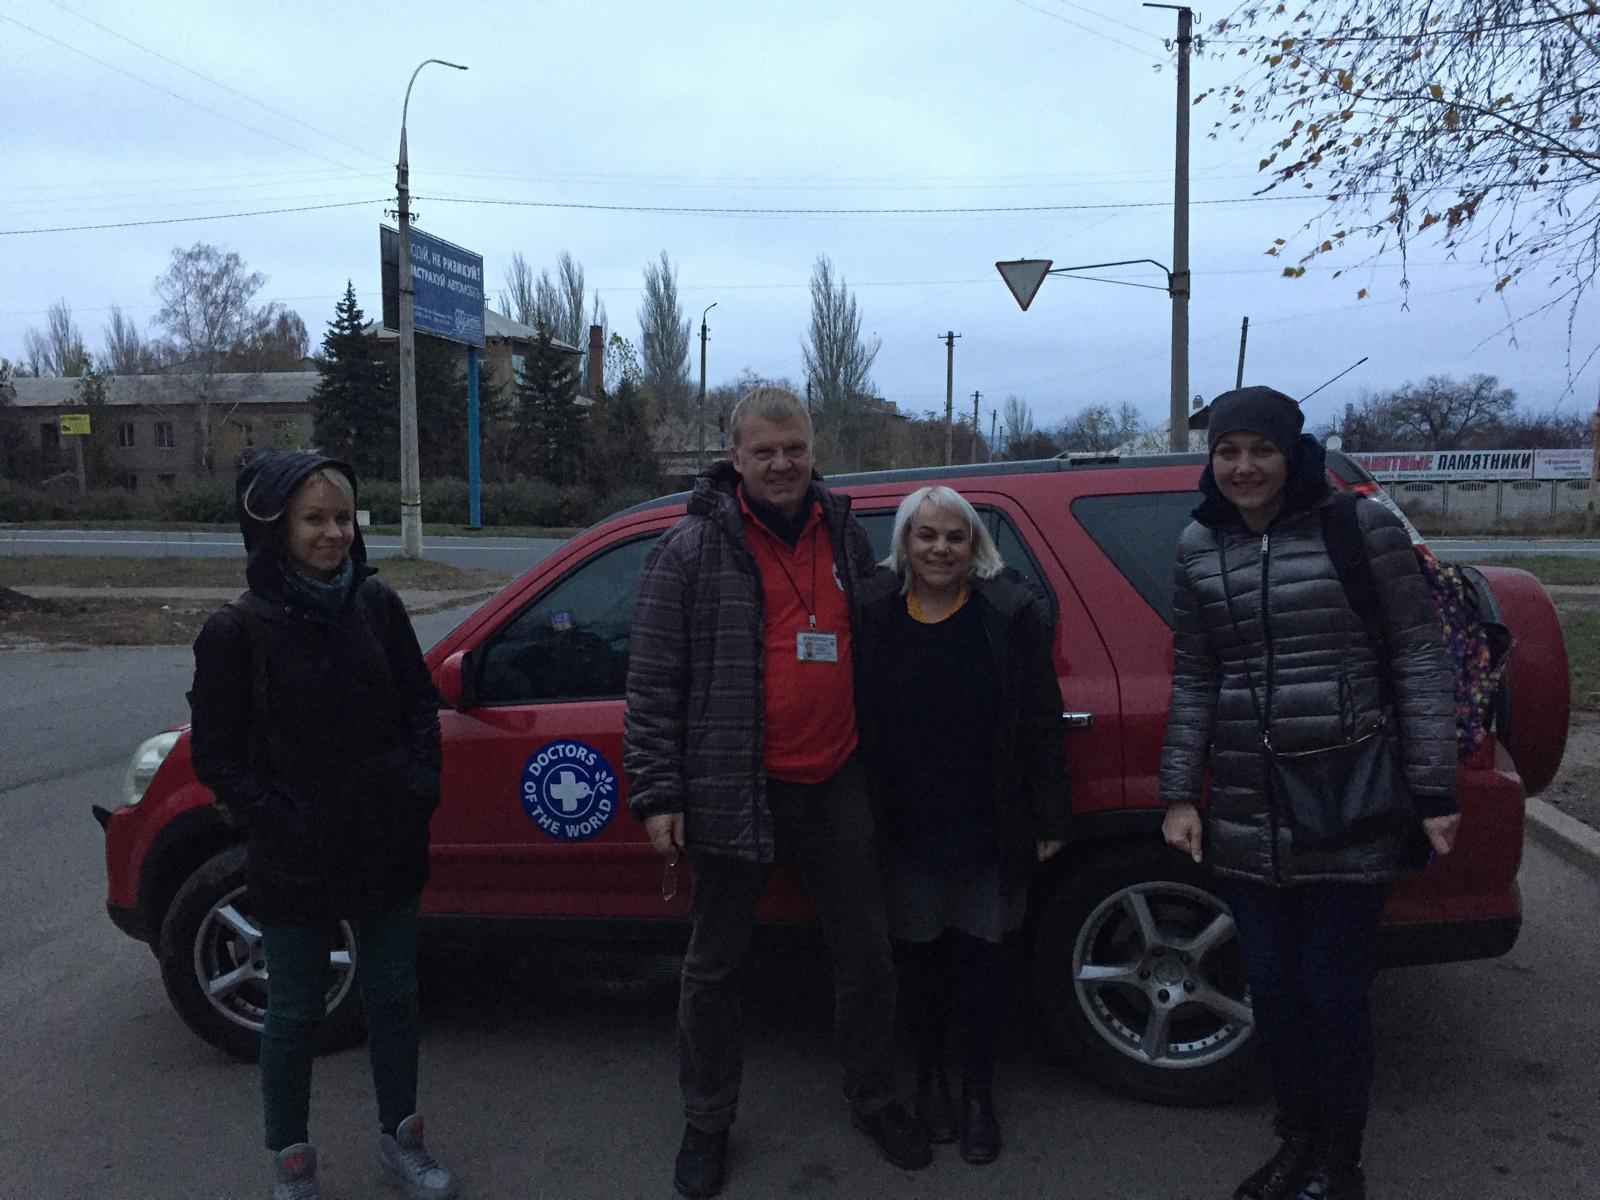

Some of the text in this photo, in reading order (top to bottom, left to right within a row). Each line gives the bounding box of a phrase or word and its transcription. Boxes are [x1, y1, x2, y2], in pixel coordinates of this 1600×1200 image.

[432, 252, 442, 268] НЕ
[1437, 453, 1532, 471] ПАМЯТНИКИ
[524, 744, 612, 837] DOCTORS OF THE WORLD
